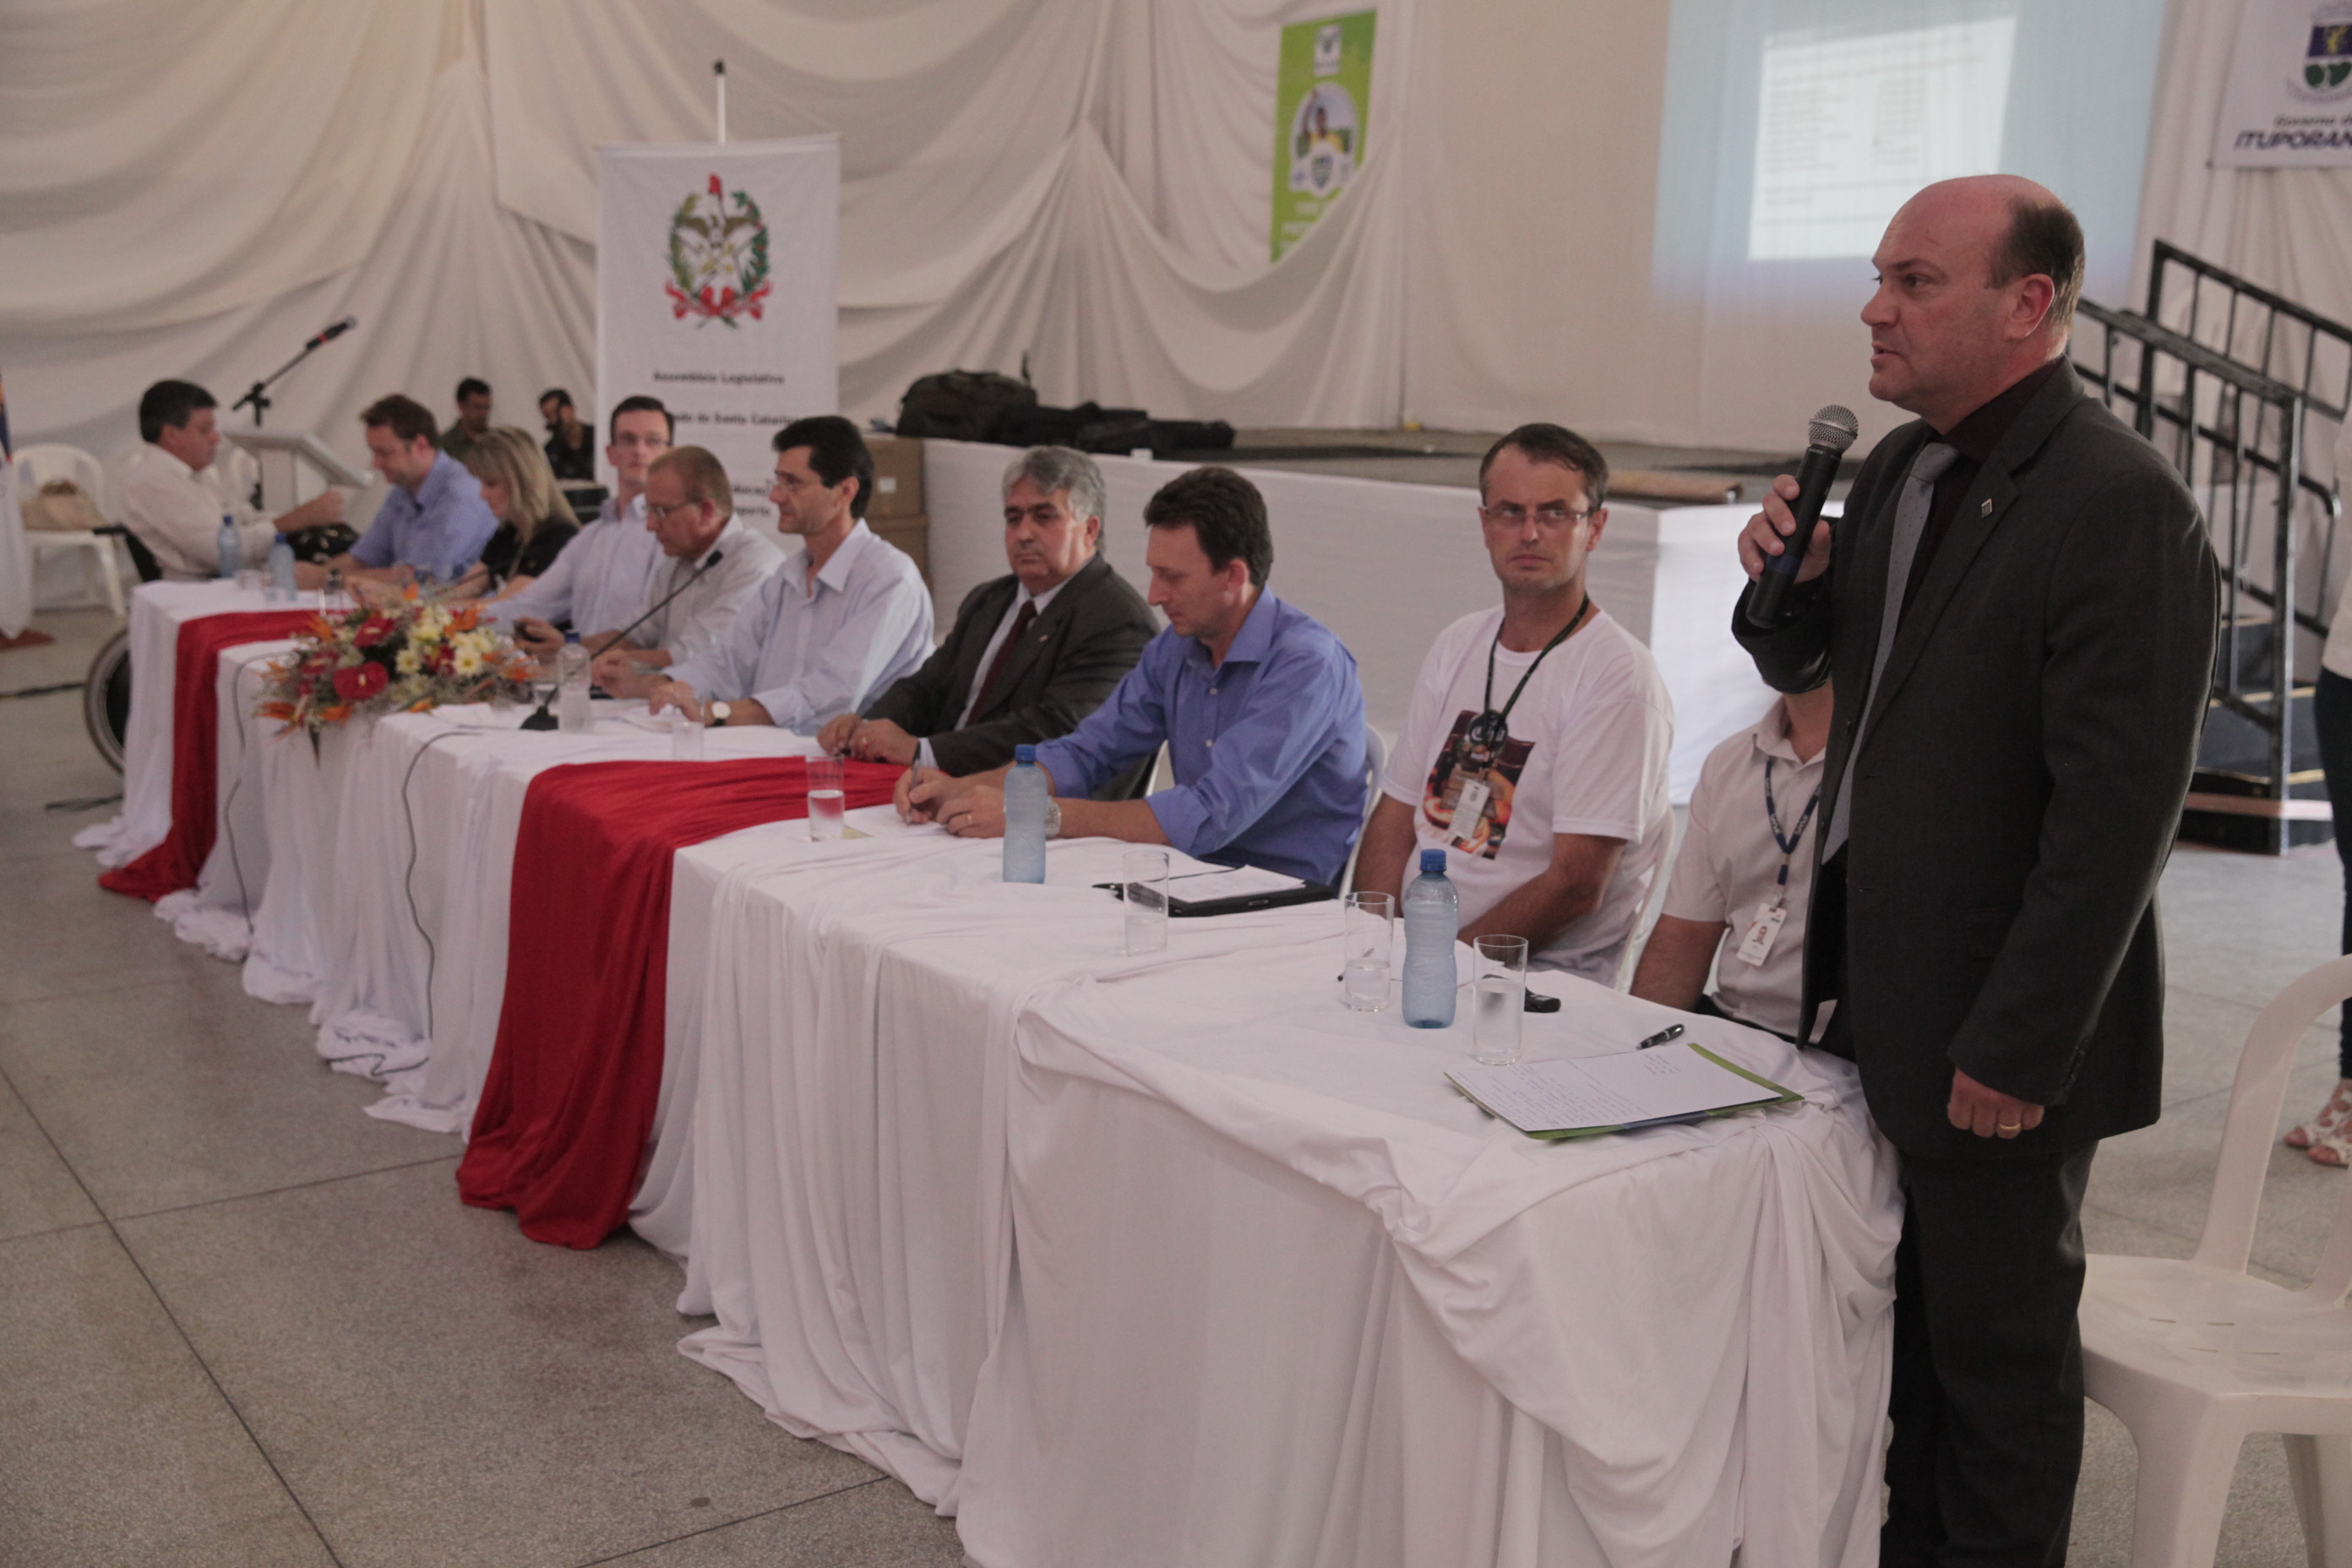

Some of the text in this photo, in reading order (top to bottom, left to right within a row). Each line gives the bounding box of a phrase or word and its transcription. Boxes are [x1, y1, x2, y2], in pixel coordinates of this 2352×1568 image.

[721, 371, 785, 385] Legislativa
[714, 411, 746, 424] Santa
[750, 412, 796, 426] Catarin
